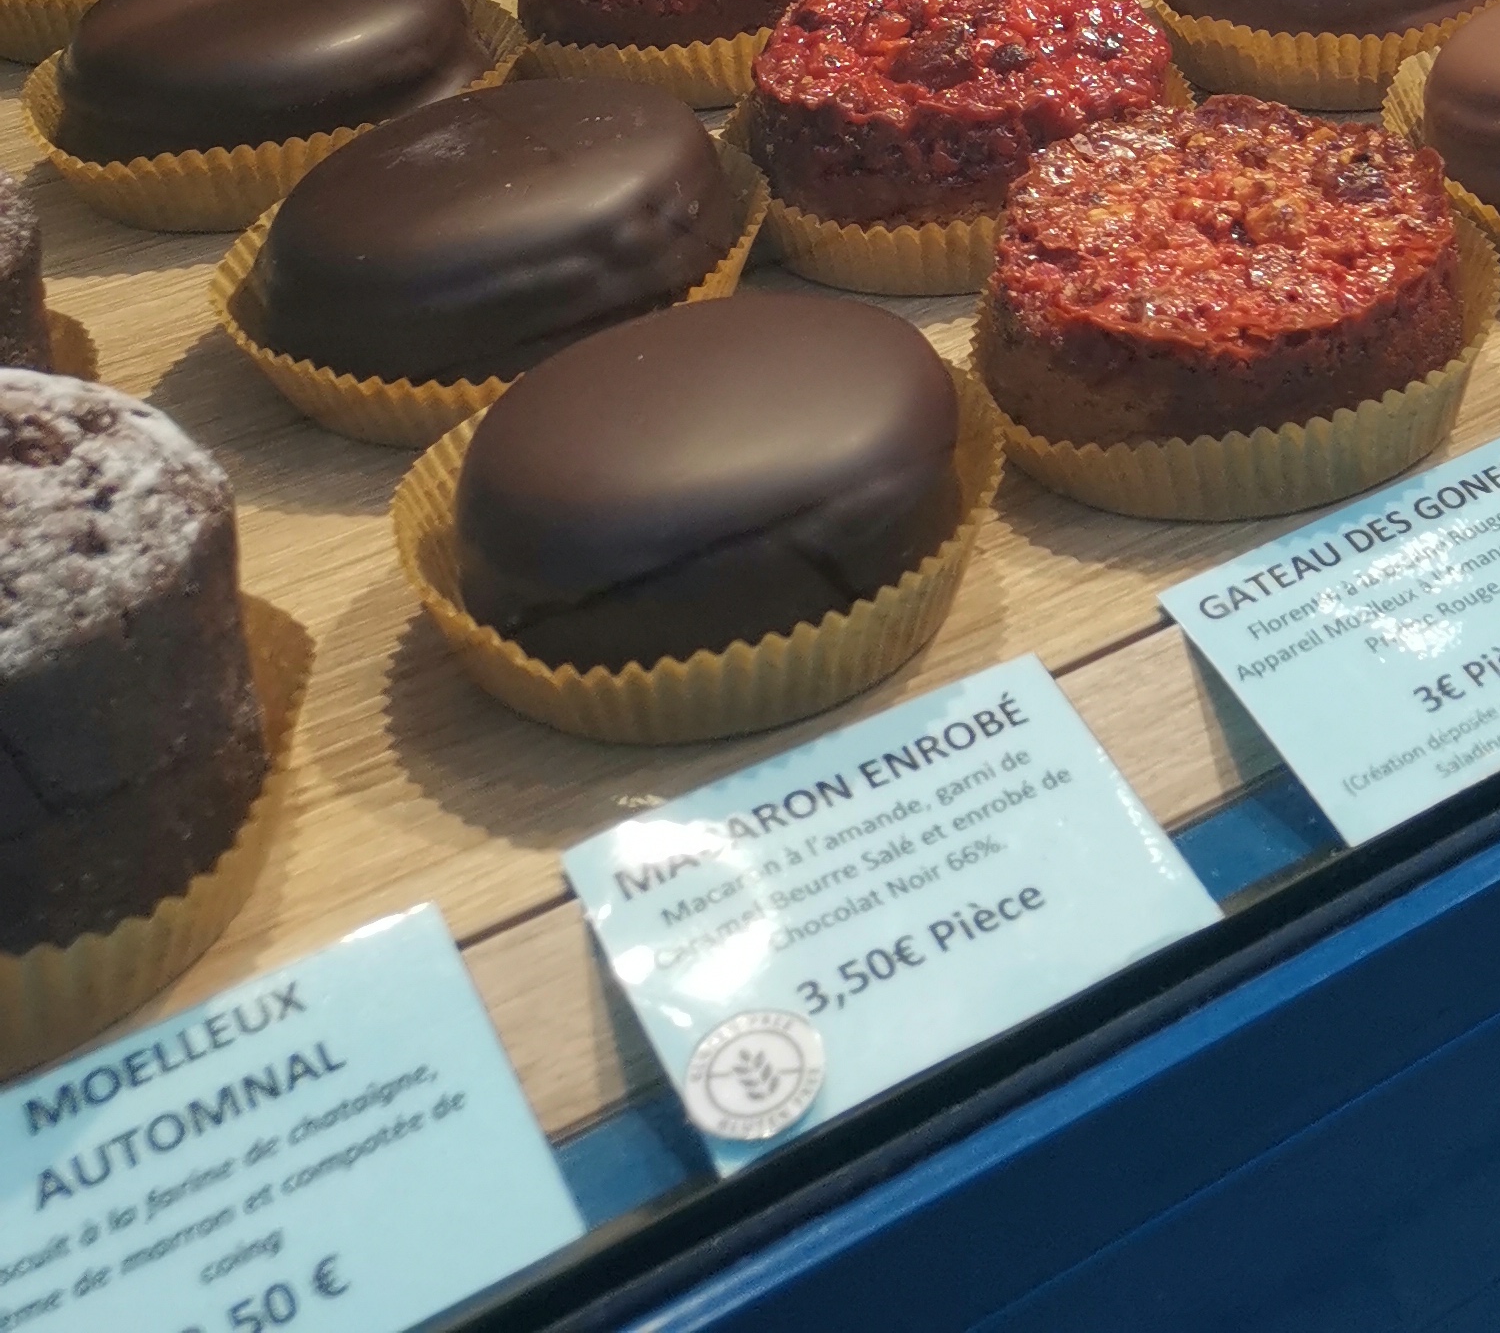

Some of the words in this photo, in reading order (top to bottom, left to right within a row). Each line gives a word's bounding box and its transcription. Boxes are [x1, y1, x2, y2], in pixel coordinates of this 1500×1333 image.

[1198, 541, 1342, 619] GATEAU
[1342, 509, 1412, 553] DES
[1236, 628, 1323, 681] Appareil
[1412, 673, 1466, 713] 3€
[857, 692, 1027, 788] ENROBÉ
[784, 846, 804, 866] à
[934, 763, 996, 806] garni
[999, 750, 1030, 772] de
[860, 835, 914, 871] Salé
[920, 823, 947, 845] et
[951, 779, 1036, 831] enrobé
[1040, 769, 1071, 790] de
[884, 865, 939, 897] Noir
[797, 934, 925, 1015] 3,50€
[927, 886, 1044, 952] Pièce
[23, 981, 307, 1135] MOELLEUX
[36, 1042, 347, 1210] AUTOMNAL
